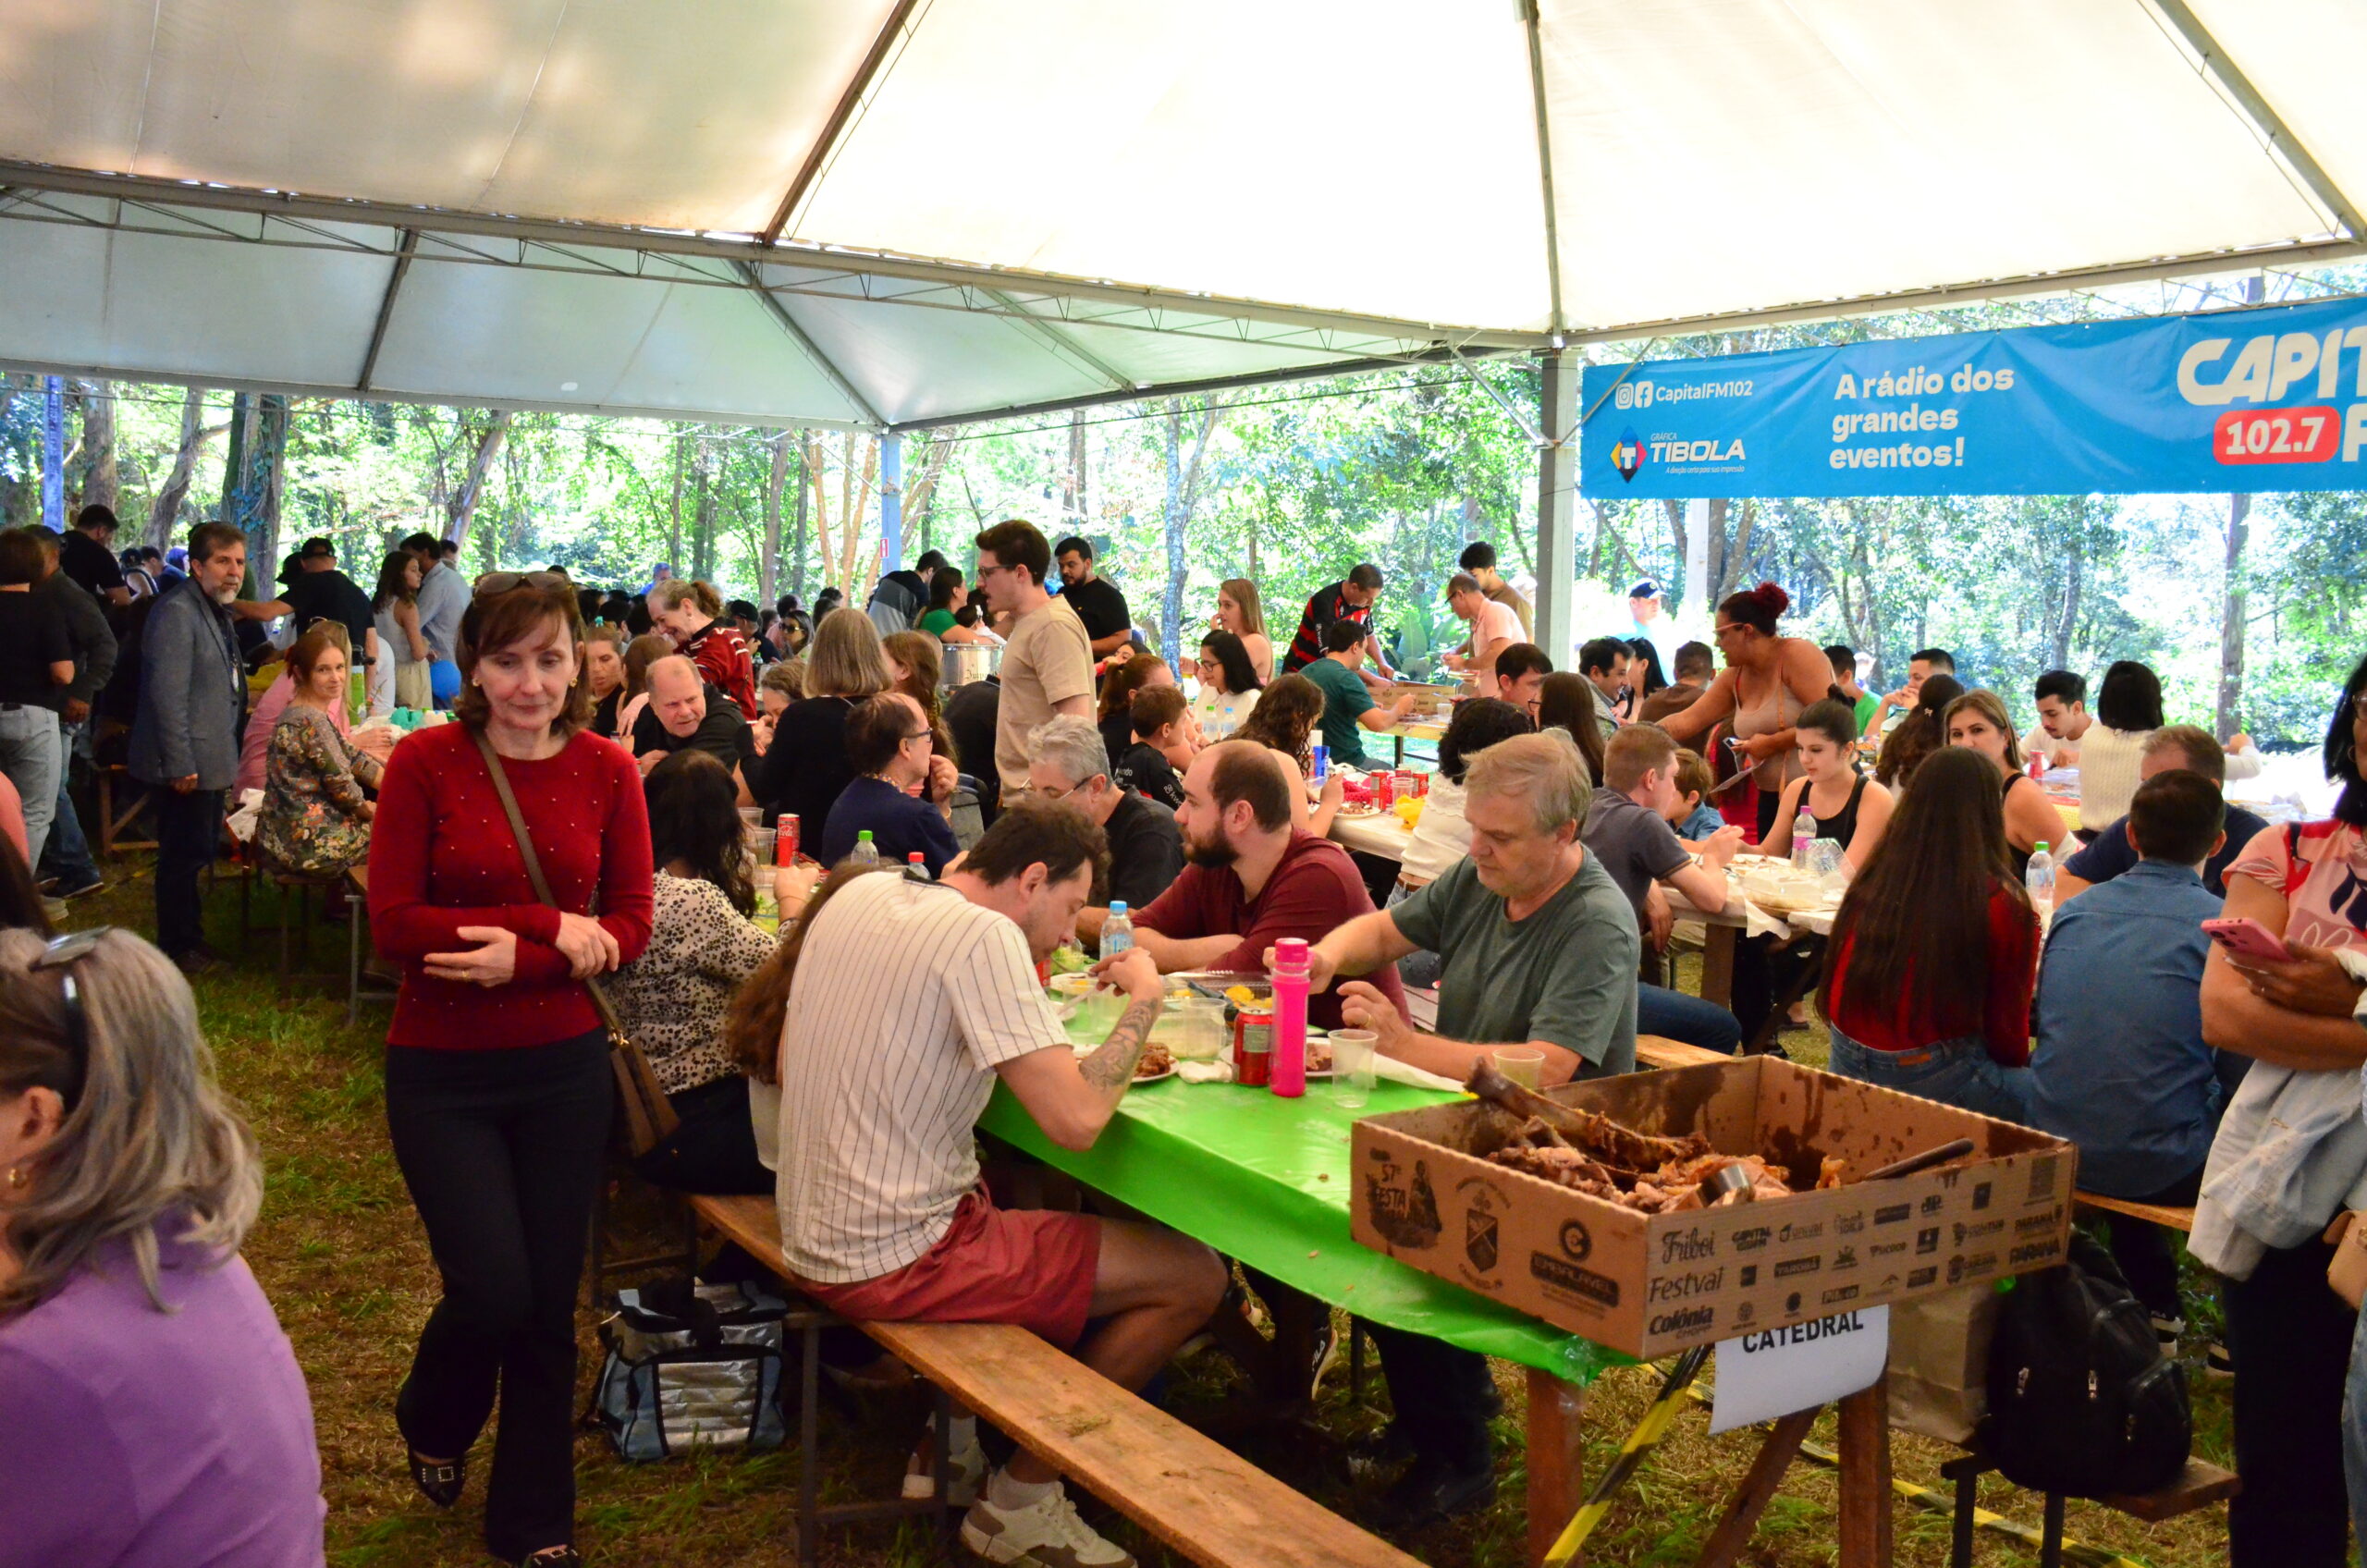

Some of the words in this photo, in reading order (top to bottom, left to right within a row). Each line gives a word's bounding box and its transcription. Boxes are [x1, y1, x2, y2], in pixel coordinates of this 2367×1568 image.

[1655, 380, 1754, 404] CapitalFM102
[1834, 374, 1858, 400] A
[1862, 365, 1944, 398] rádio
[1951, 362, 2015, 393] dos
[1832, 402, 1959, 443] grandes
[2226, 416, 2326, 456] 102.7
[1650, 438, 1747, 463] TIBOLA
[1829, 436, 1966, 470] eventos!
[1662, 1226, 1716, 1265] Friboi
[1649, 1265, 1724, 1304] Festval
[1649, 1304, 1715, 1336] Colônia
[1742, 1307, 1864, 1354] CATEDRAL
